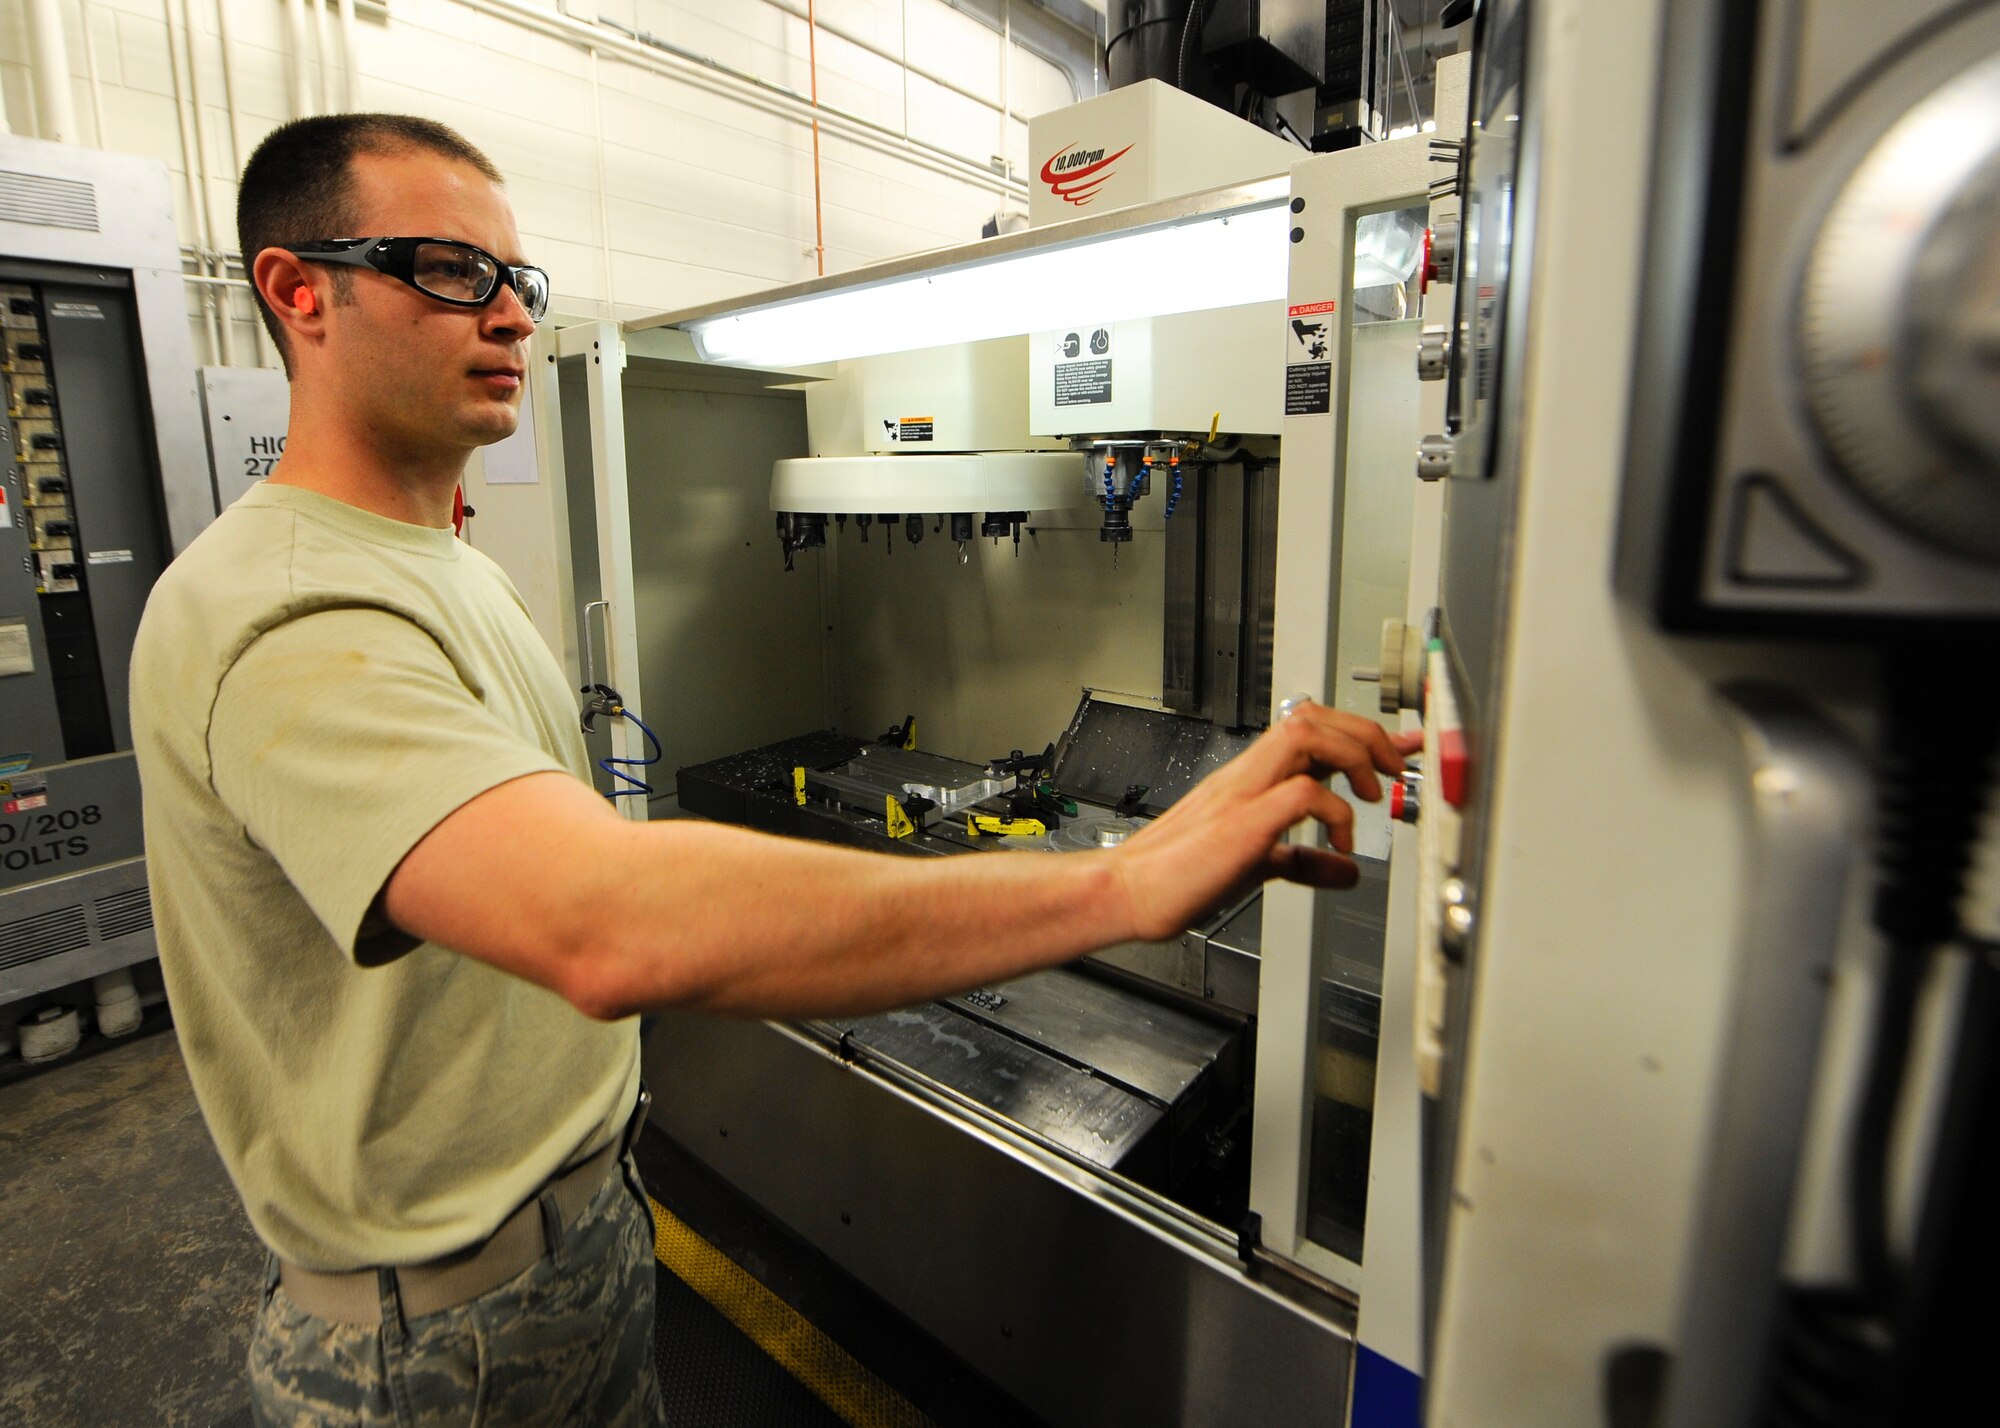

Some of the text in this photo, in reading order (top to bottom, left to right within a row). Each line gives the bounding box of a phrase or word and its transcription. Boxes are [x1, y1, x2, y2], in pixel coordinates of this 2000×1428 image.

[1055, 148, 1105, 172] 10,000rpm
[1299, 303, 1333, 314] DANGER
[244, 457, 280, 476] 27
[0, 835, 90, 871] OLTS
